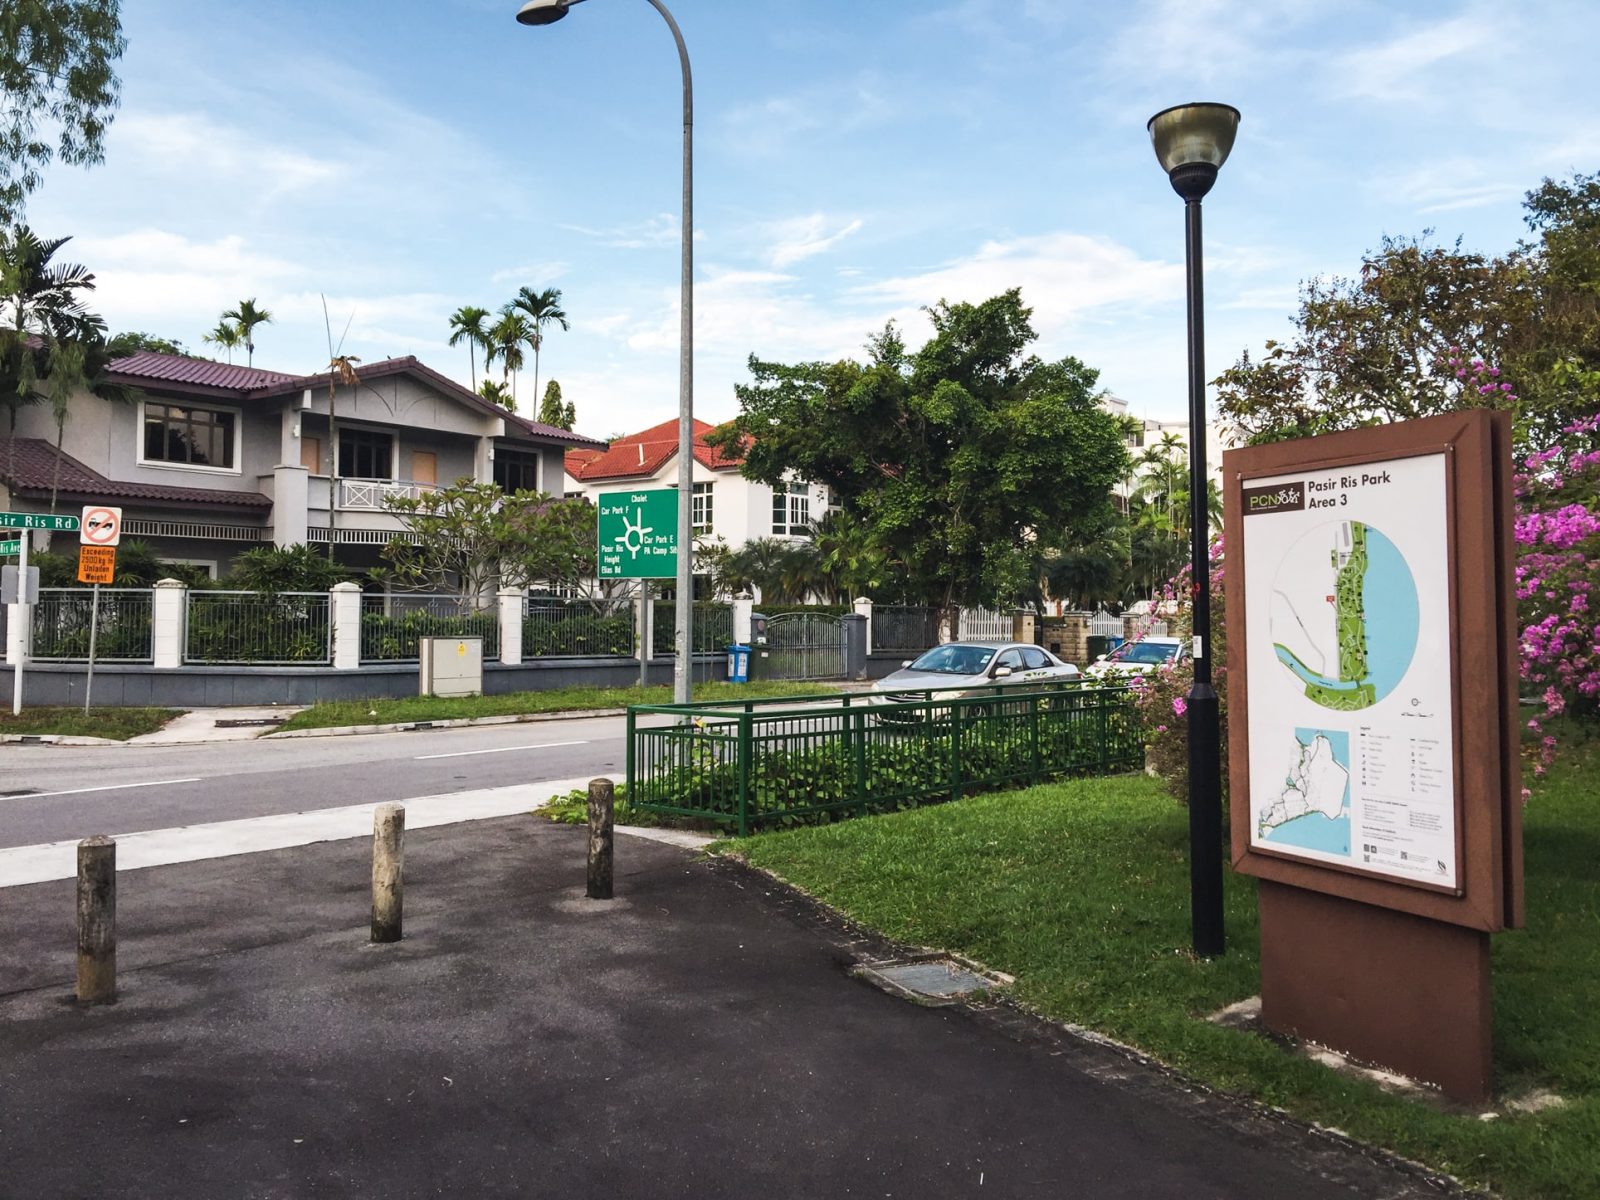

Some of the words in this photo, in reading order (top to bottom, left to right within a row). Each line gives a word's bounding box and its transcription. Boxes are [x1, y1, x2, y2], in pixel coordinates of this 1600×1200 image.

[1308, 477, 1337, 492] Pasir
[1341, 475, 1357, 489] Ris
[1361, 470, 1391, 486] Park
[1249, 494, 1278, 508] PCN
[1308, 496, 1336, 509] Area
[1340, 494, 1348, 506] 3
[601, 507, 610, 515] Car
[612, 506, 624, 514] Park
[25, 515, 46, 528] Ris
[55, 518, 72, 529] Rd
[644, 535, 654, 544] Car
[656, 535, 668, 543] Park
[653, 546, 667, 556] Camp
